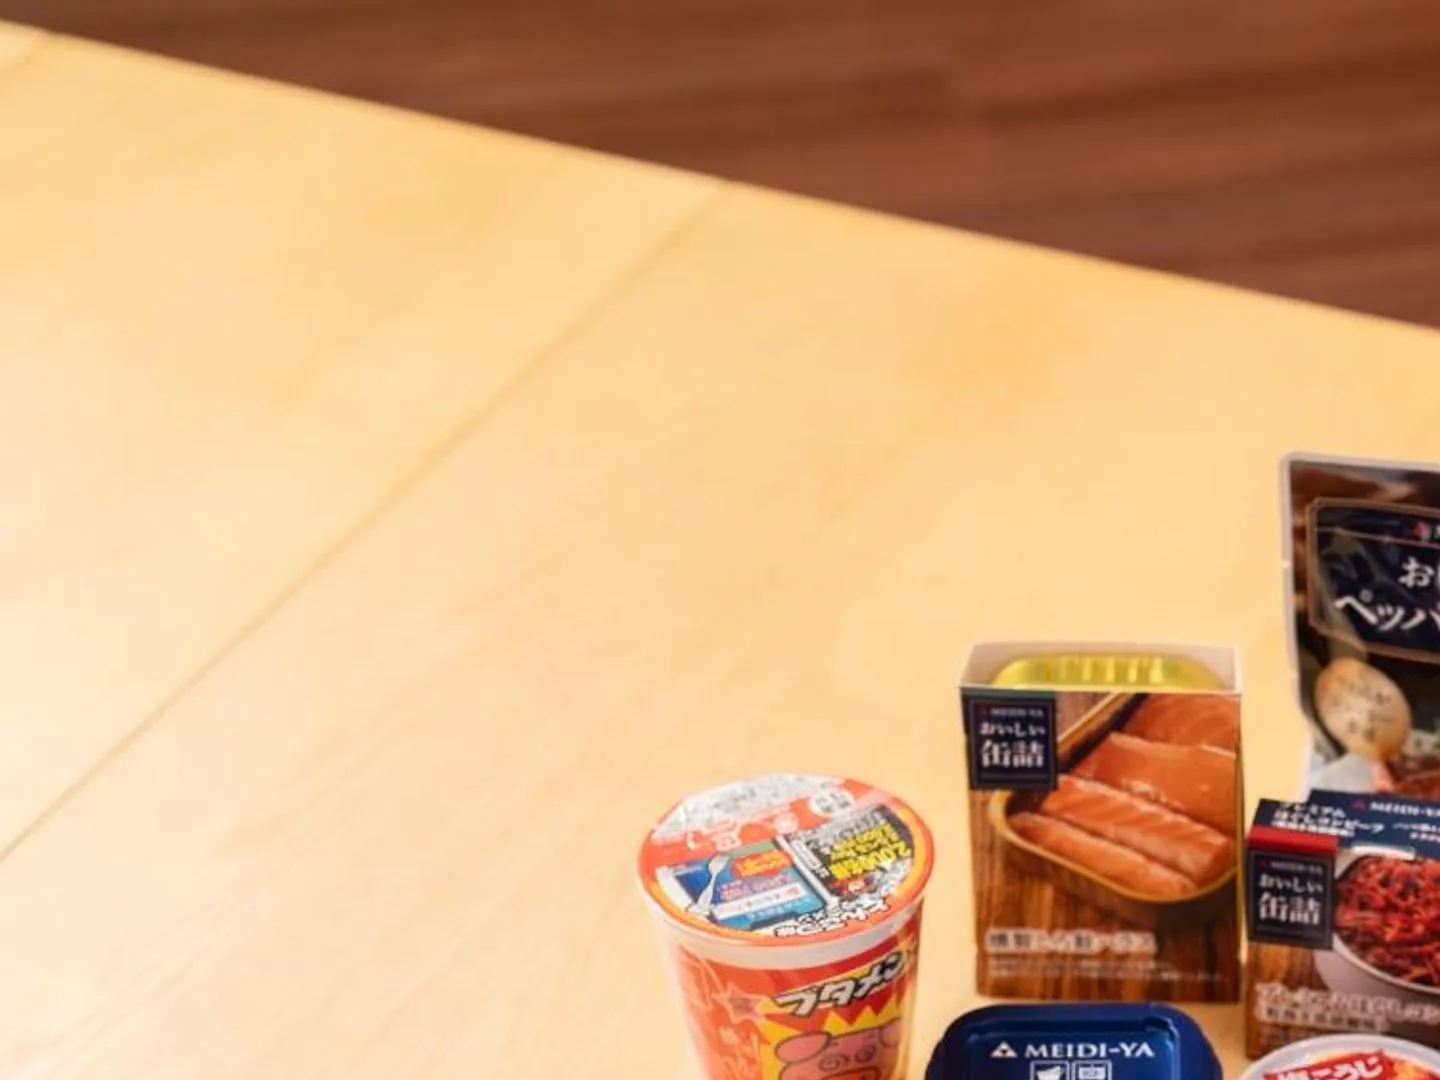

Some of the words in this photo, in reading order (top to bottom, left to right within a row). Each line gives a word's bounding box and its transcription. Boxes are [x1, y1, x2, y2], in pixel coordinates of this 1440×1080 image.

[980, 721, 1046, 738] おいしい
[981, 739, 1045, 768] 缶詰
[1259, 874, 1324, 893] おいしい
[1259, 893, 1322, 925] 缶詰
[1024, 1042, 1155, 1059] MEIDI-YA
